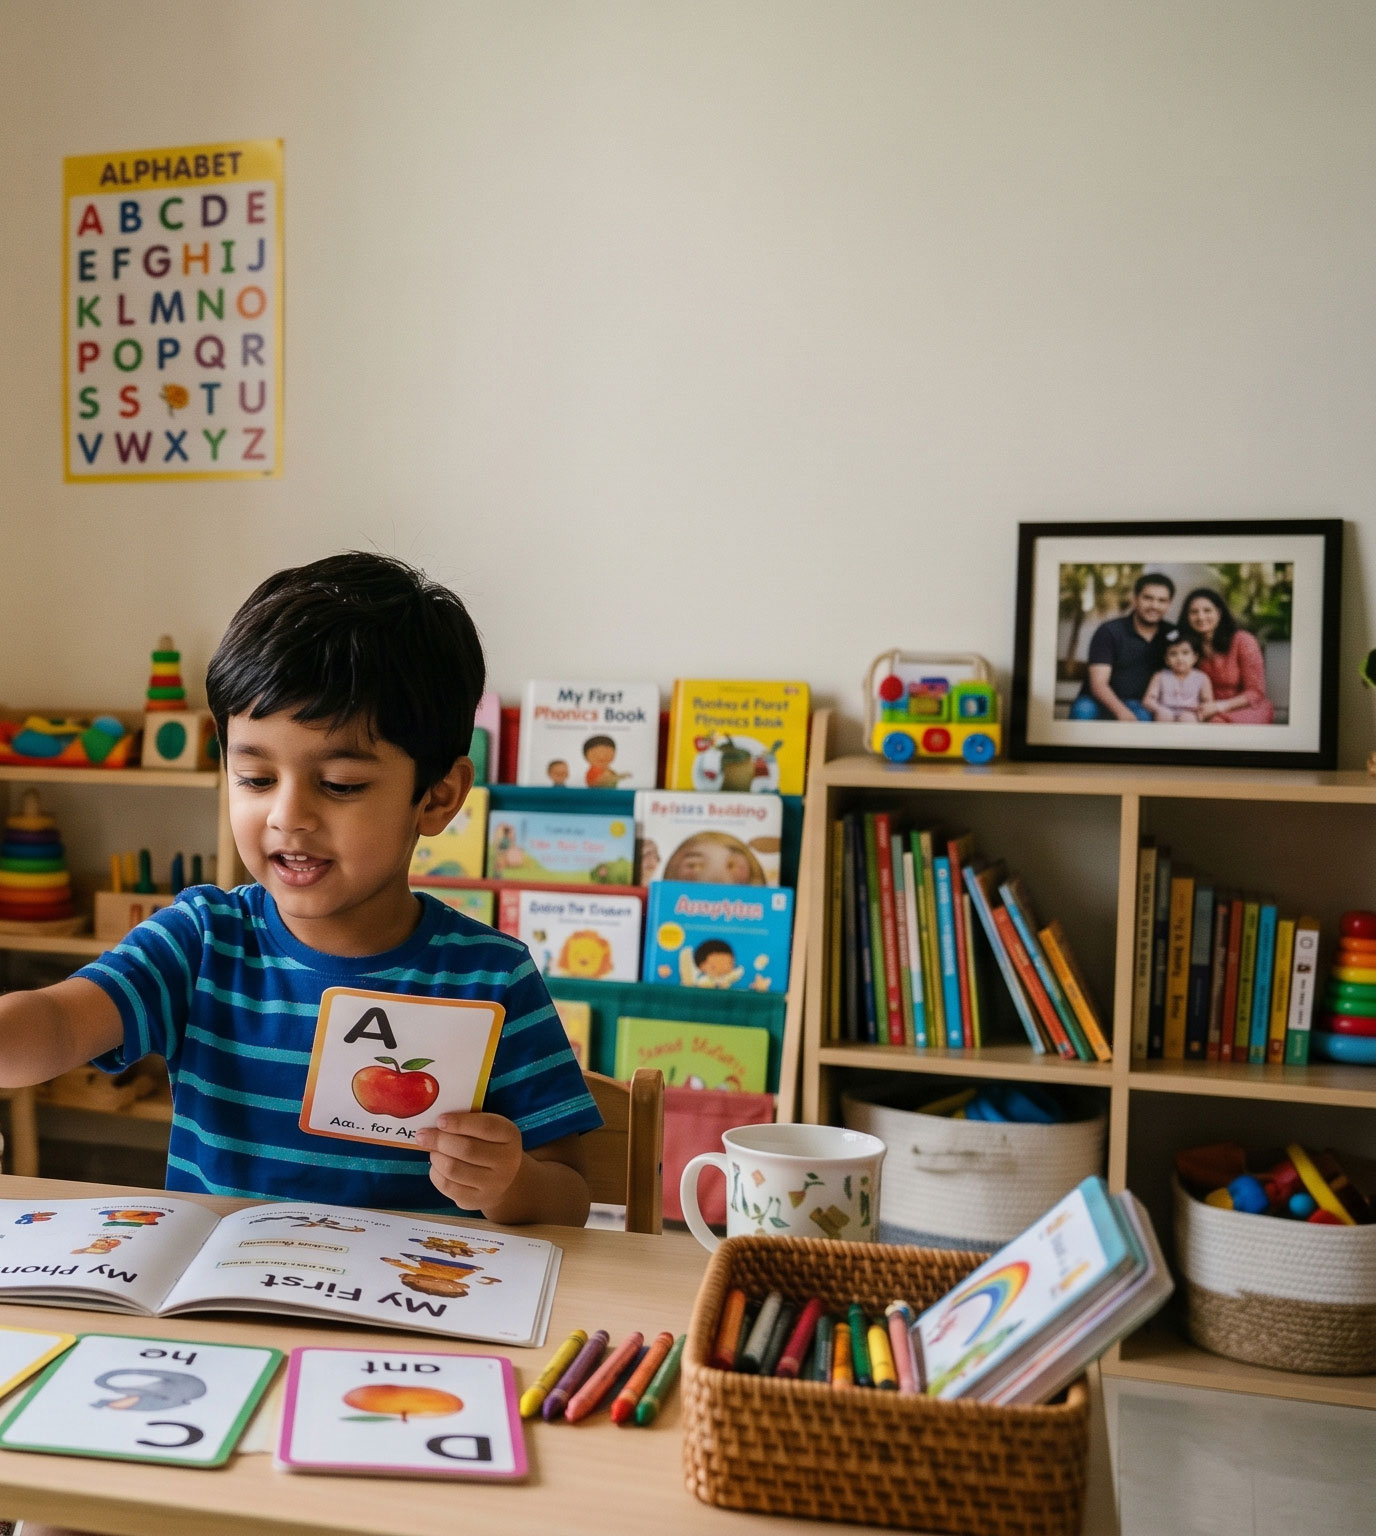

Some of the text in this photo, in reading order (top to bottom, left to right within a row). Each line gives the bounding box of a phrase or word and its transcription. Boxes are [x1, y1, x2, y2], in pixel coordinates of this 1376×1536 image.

[99, 150, 243, 187] ALPHABET
[77, 191, 265, 237] A B C D E
[78, 239, 265, 282] E F G H I J
[77, 285, 267, 329] K L M N O
[77, 334, 265, 374] P O P Q R
[79, 381, 265, 420] S S T U
[77, 428, 265, 464] V W X Y Z
[534, 705, 646, 722] Phonics Book
[558, 688, 623, 707] My First
[343, 1007, 397, 1049] A
[371, 1122, 392, 1134] for
[88, 1263, 138, 1283] My
[261, 1273, 447, 1317] My First
[139, 1348, 198, 1365] he
[361, 1360, 441, 1374] ant
[136, 1421, 204, 1448] C
[426, 1434, 492, 1461] D
